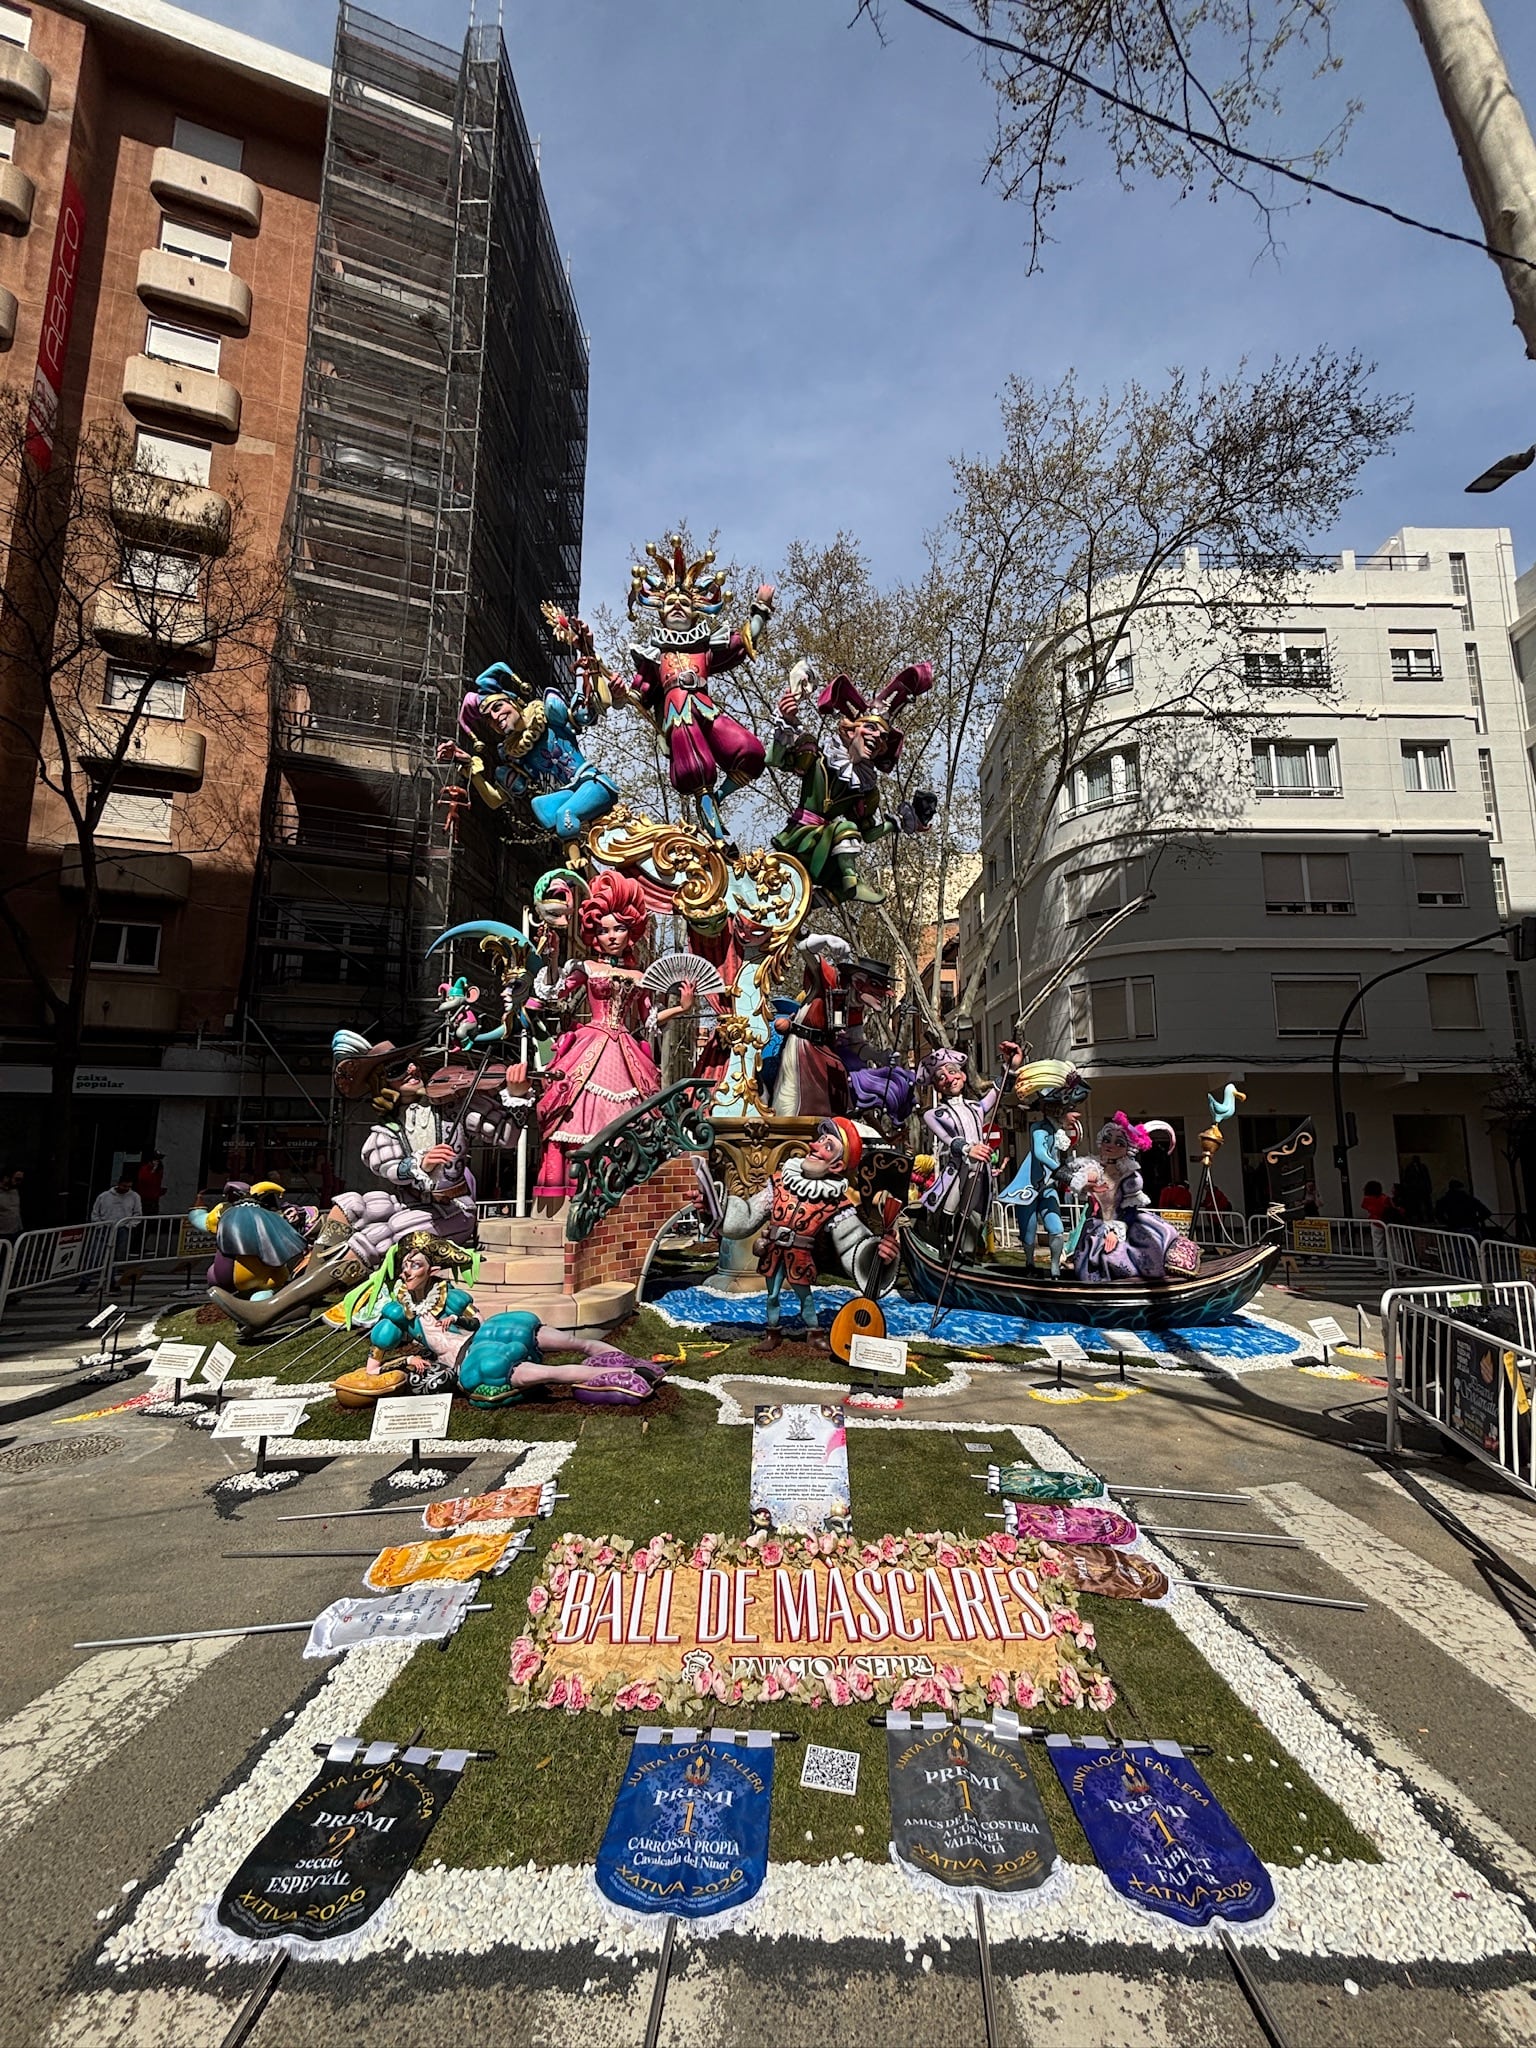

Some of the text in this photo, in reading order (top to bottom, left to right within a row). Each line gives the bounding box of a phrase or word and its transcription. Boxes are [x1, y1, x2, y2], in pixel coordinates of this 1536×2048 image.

[44, 205, 80, 373] ÁBACO
[76, 1080, 125, 1089] popular
[556, 1567, 682, 1645] BALL
[697, 1566, 760, 1643] DE
[924, 1725, 971, 1747] LOCAL
[974, 1733, 1028, 1780] FALLERA
[627, 1743, 765, 1794] JUNTA LOCAL FALLERA
[924, 1766, 1002, 1791] PREMI
[1072, 1751, 1210, 1807] JUNTA LOCAL FALLERA
[293, 1761, 435, 1820] JUNTA LOCAL FALLERA
[653, 1787, 734, 1807] PREMI
[956, 1780, 976, 1813] 1
[310, 1810, 399, 1832] PREMI
[676, 1800, 699, 1836] 1
[1106, 1795, 1191, 1819] PREMI
[903, 1812, 1041, 1834] AMICS DE LA COSTERA
[942, 1830, 952, 1839] A
[978, 1830, 1004, 1842] DEL
[1149, 1810, 1181, 1848] 1
[323, 1826, 356, 1859] 2
[627, 1836, 692, 1853] CARROSSA
[633, 1851, 730, 1870] Cavalcada del Ninot
[992, 1849, 1038, 1875] 2026
[690, 1866, 744, 1896] 2026
[1211, 1879, 1253, 1902] 2026
[305, 1885, 366, 1920] 2026
